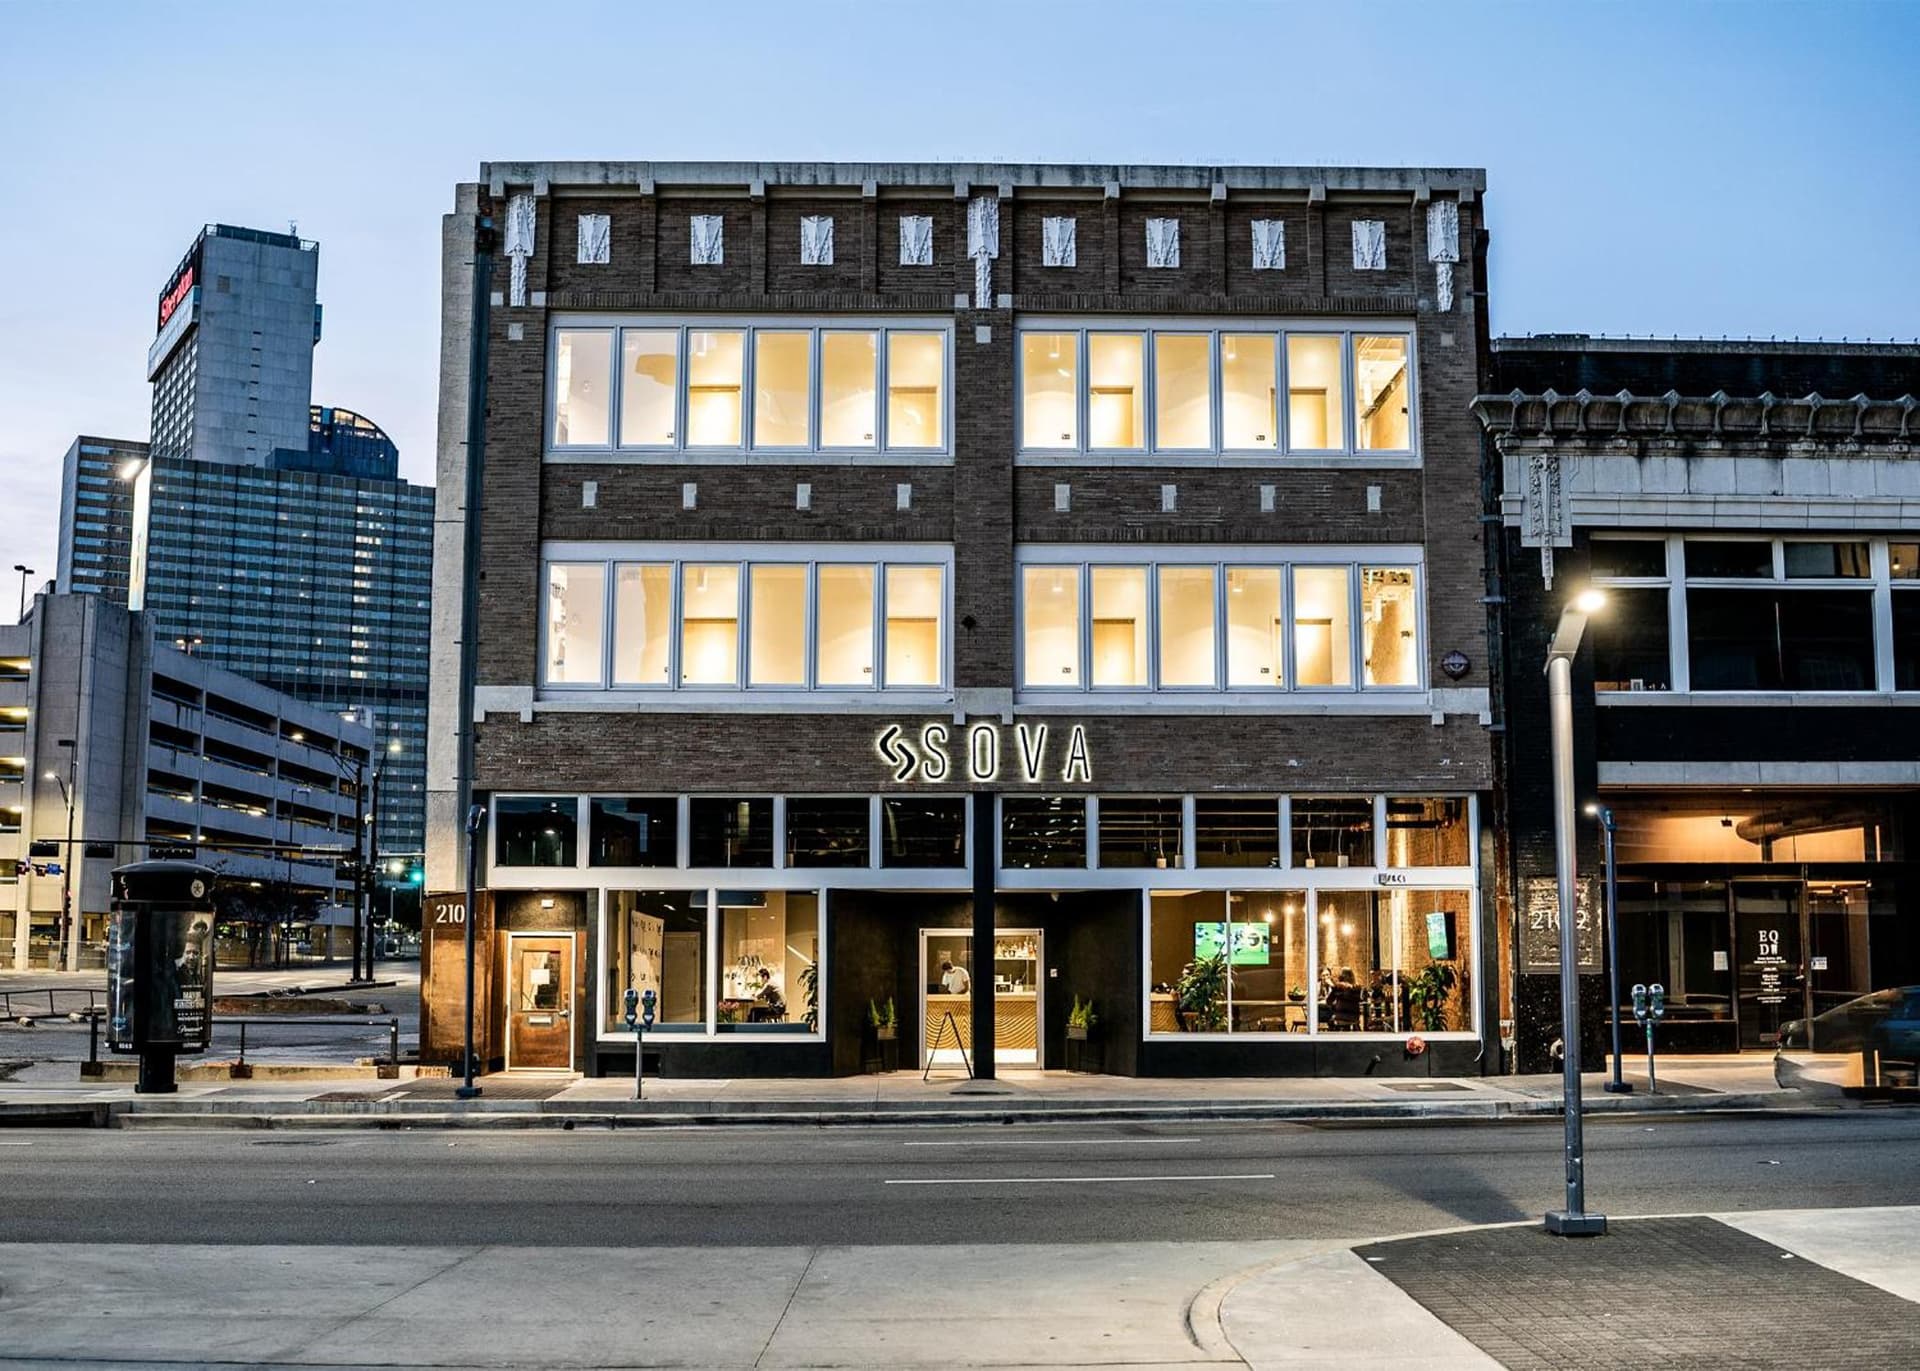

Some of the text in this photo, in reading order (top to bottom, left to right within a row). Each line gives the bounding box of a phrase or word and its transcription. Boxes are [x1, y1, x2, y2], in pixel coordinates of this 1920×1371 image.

[923, 725, 1091, 780] SOVA
[436, 904, 476, 923] 210
[1758, 929, 1779, 944] EQ
